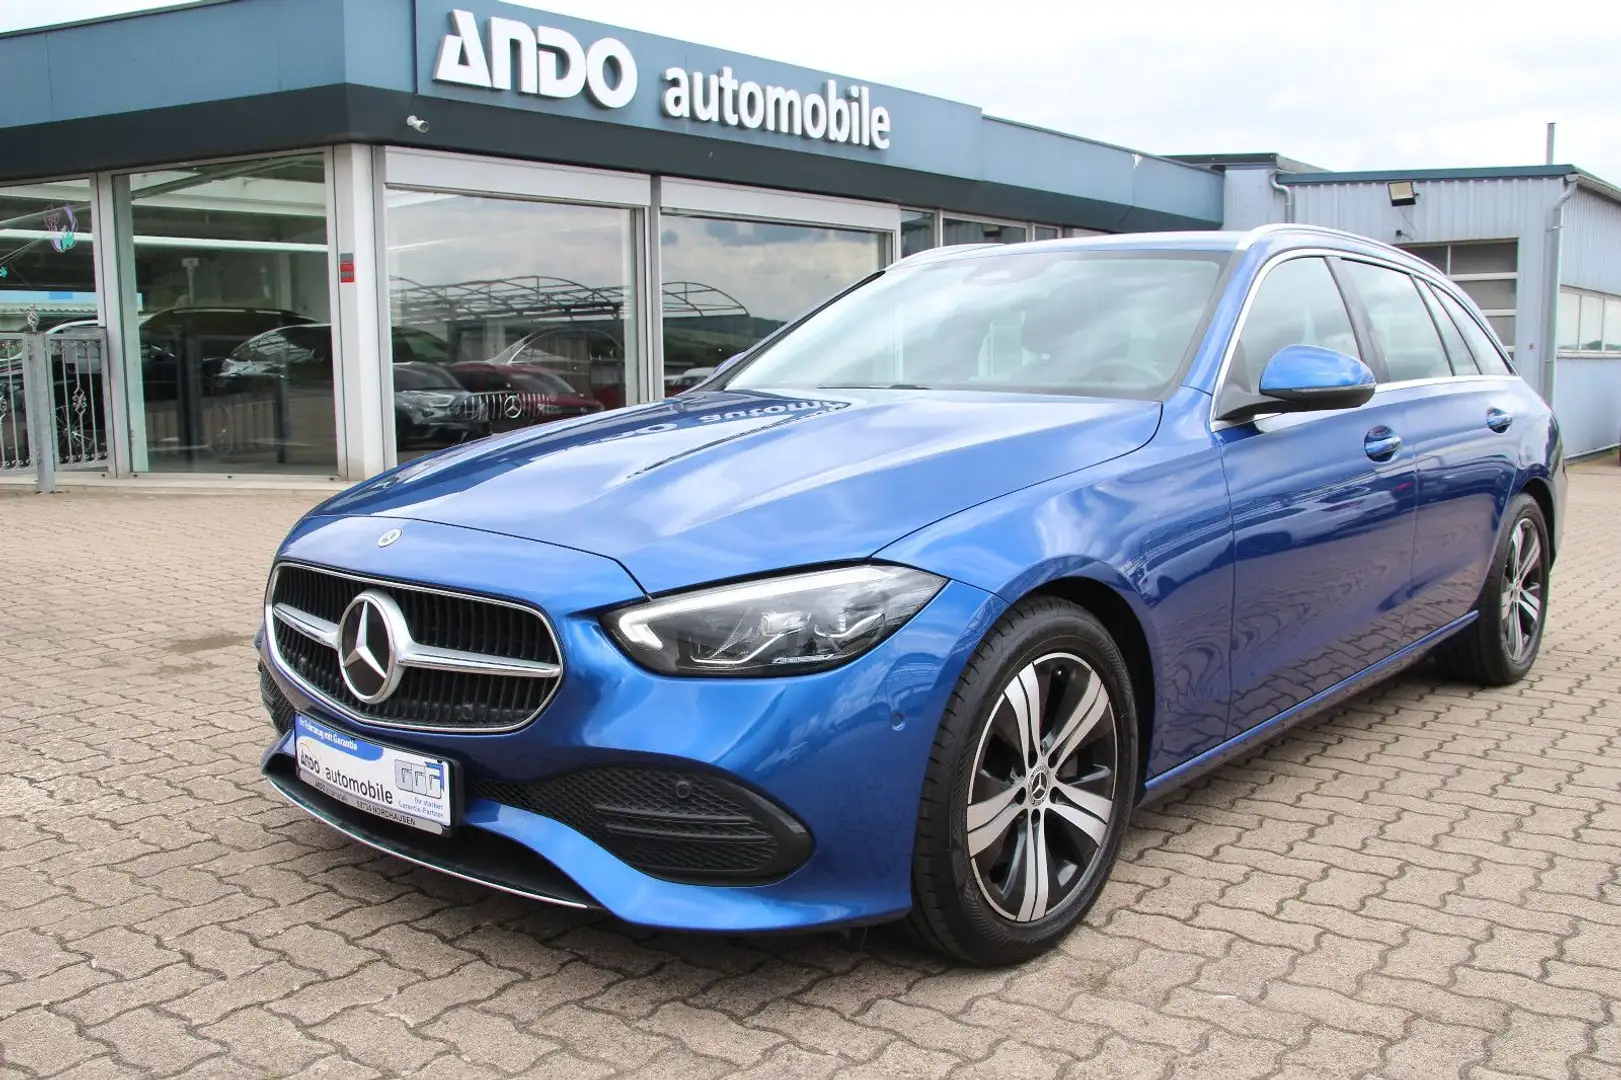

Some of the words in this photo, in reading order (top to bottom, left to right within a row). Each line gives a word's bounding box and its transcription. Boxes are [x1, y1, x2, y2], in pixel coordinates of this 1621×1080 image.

[432, 8, 638, 109] ANDO
[660, 65, 891, 151] automobile
[324, 730, 334, 742] mit
[333, 733, 358, 750] Garantie
[325, 766, 393, 804] automobile
[371, 805, 416, 826] NORDHAUSEN
